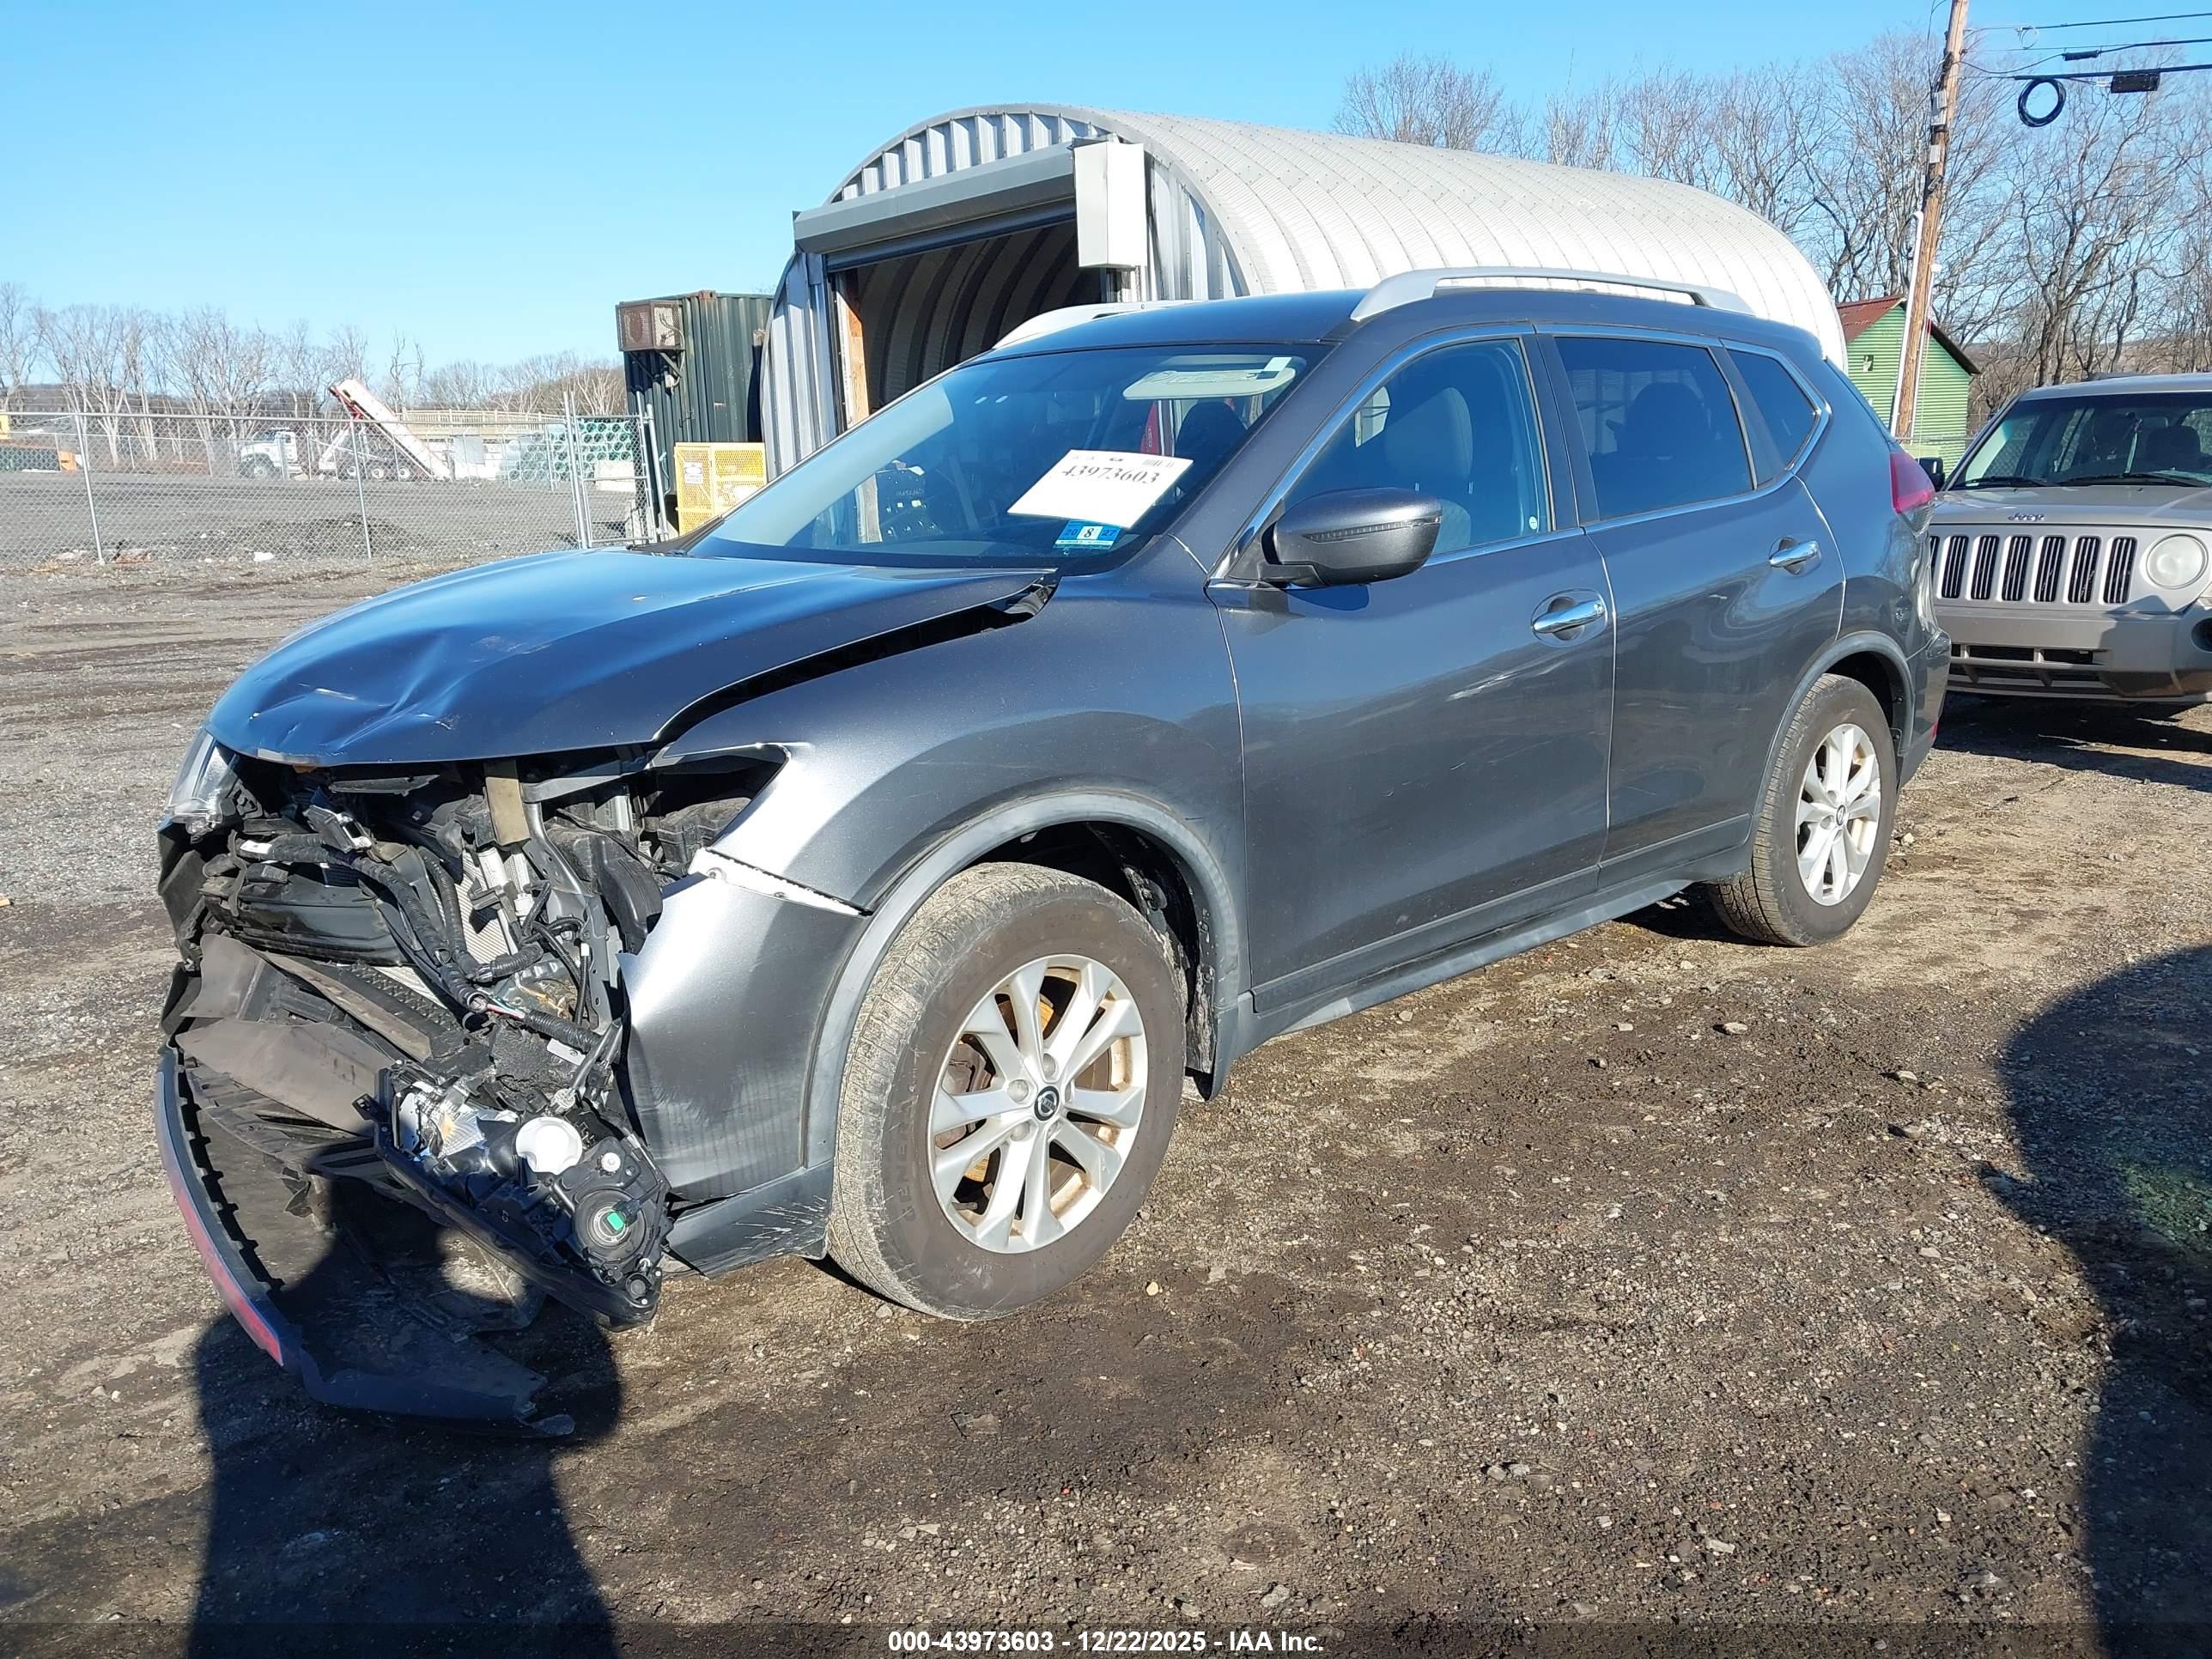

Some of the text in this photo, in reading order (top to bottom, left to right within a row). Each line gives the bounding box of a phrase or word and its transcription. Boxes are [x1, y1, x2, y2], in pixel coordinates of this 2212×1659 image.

[1062, 465, 1160, 484] 43973603
[2008, 512, 2045, 522] Jeep
[1084, 527, 1095, 538] 8
[1101, 528, 1116, 537] 27
